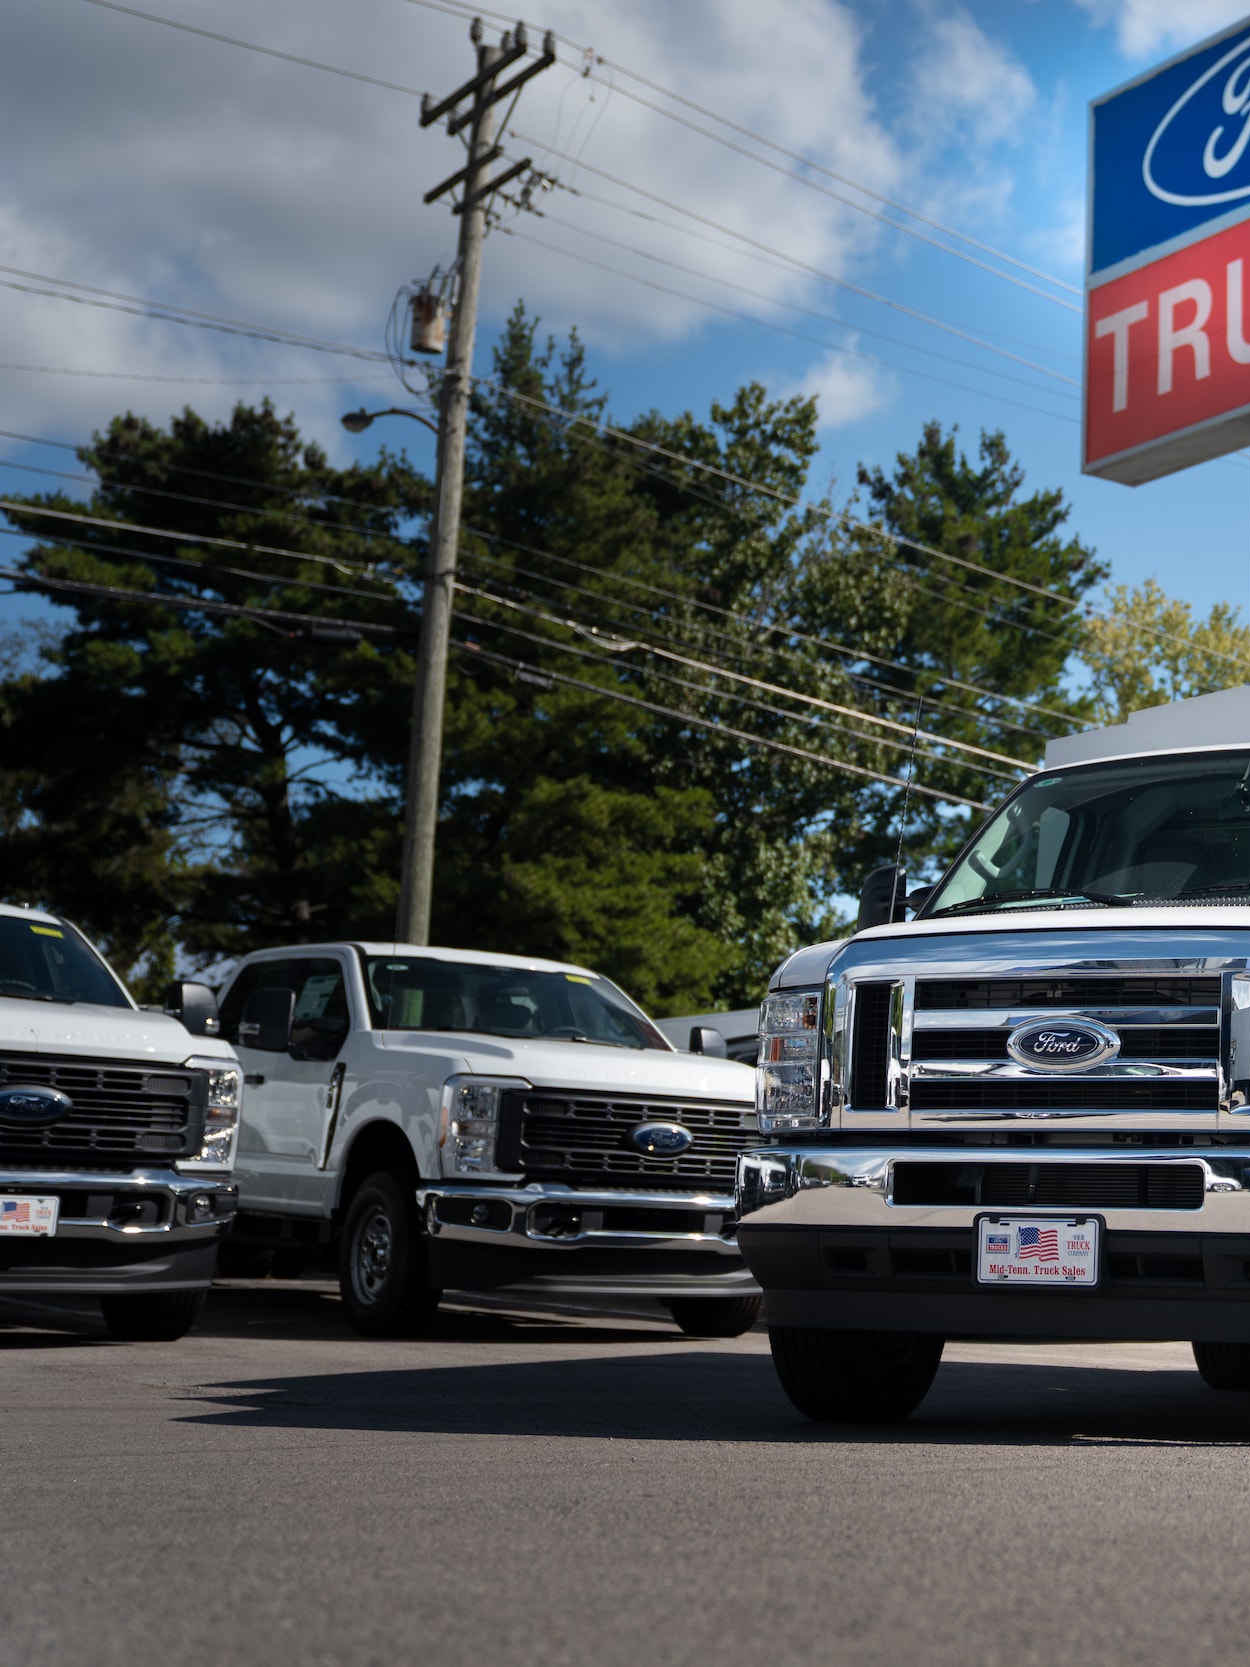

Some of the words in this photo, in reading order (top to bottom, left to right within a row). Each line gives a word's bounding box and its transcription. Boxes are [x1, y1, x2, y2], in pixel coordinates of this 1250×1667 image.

[1033, 1032, 1082, 1053] Ford
[1066, 1241, 1090, 1250] TRUCK
[989, 1264, 1031, 1275] Mid-Tenn.
[1034, 1266, 1060, 1275] Truck
[1062, 1266, 1086, 1276] Sales
